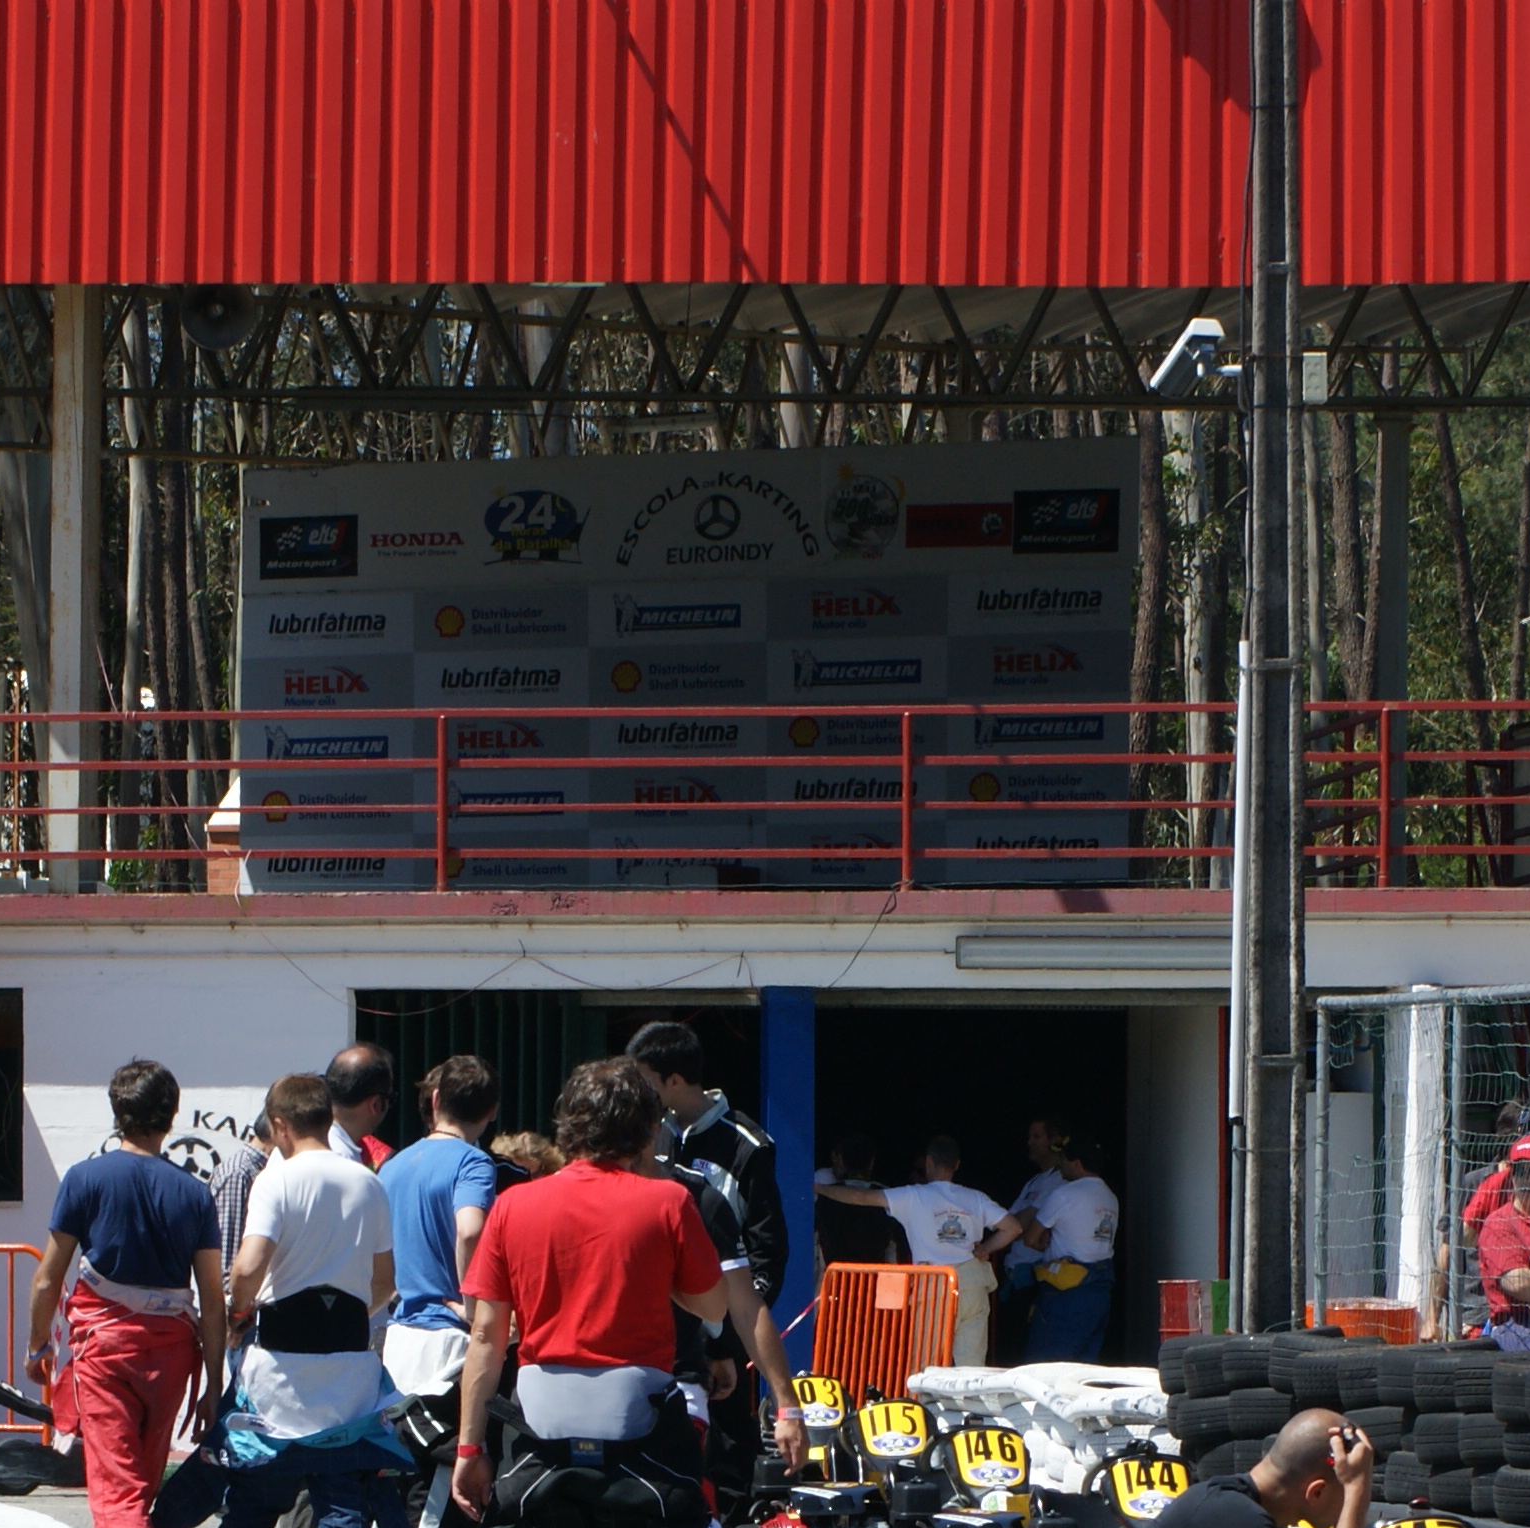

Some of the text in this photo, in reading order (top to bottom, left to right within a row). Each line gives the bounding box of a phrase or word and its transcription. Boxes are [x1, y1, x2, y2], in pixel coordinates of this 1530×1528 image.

[497, 492, 557, 533] 24
[616, 476, 700, 567] ESCOLA
[717, 471, 820, 558] KARTING
[370, 531, 465, 548] HONDA
[266, 556, 338, 570] Motorsport
[665, 542, 775, 566] EUROINDY
[641, 605, 738, 626] MICHELIN
[812, 594, 899, 617] HELIX
[471, 620, 568, 636] Shell Lubricants
[819, 660, 919, 680] MICHELIN
[993, 651, 1081, 673] HELIX
[284, 674, 368, 695] HELIX
[649, 675, 744, 691] Shell Lubricants
[284, 697, 315, 706] Motor
[1000, 719, 1100, 736] MICHELIN
[291, 738, 384, 757] MICHELIN
[457, 729, 544, 750] HELIX
[634, 785, 722, 804] HELIX
[472, 863, 568, 878] Shell Lubricants
[812, 863, 844, 875] Motor
[867, 1403, 918, 1438] 115
[964, 1430, 1018, 1464] 146
[1123, 1461, 1179, 1495] 144
